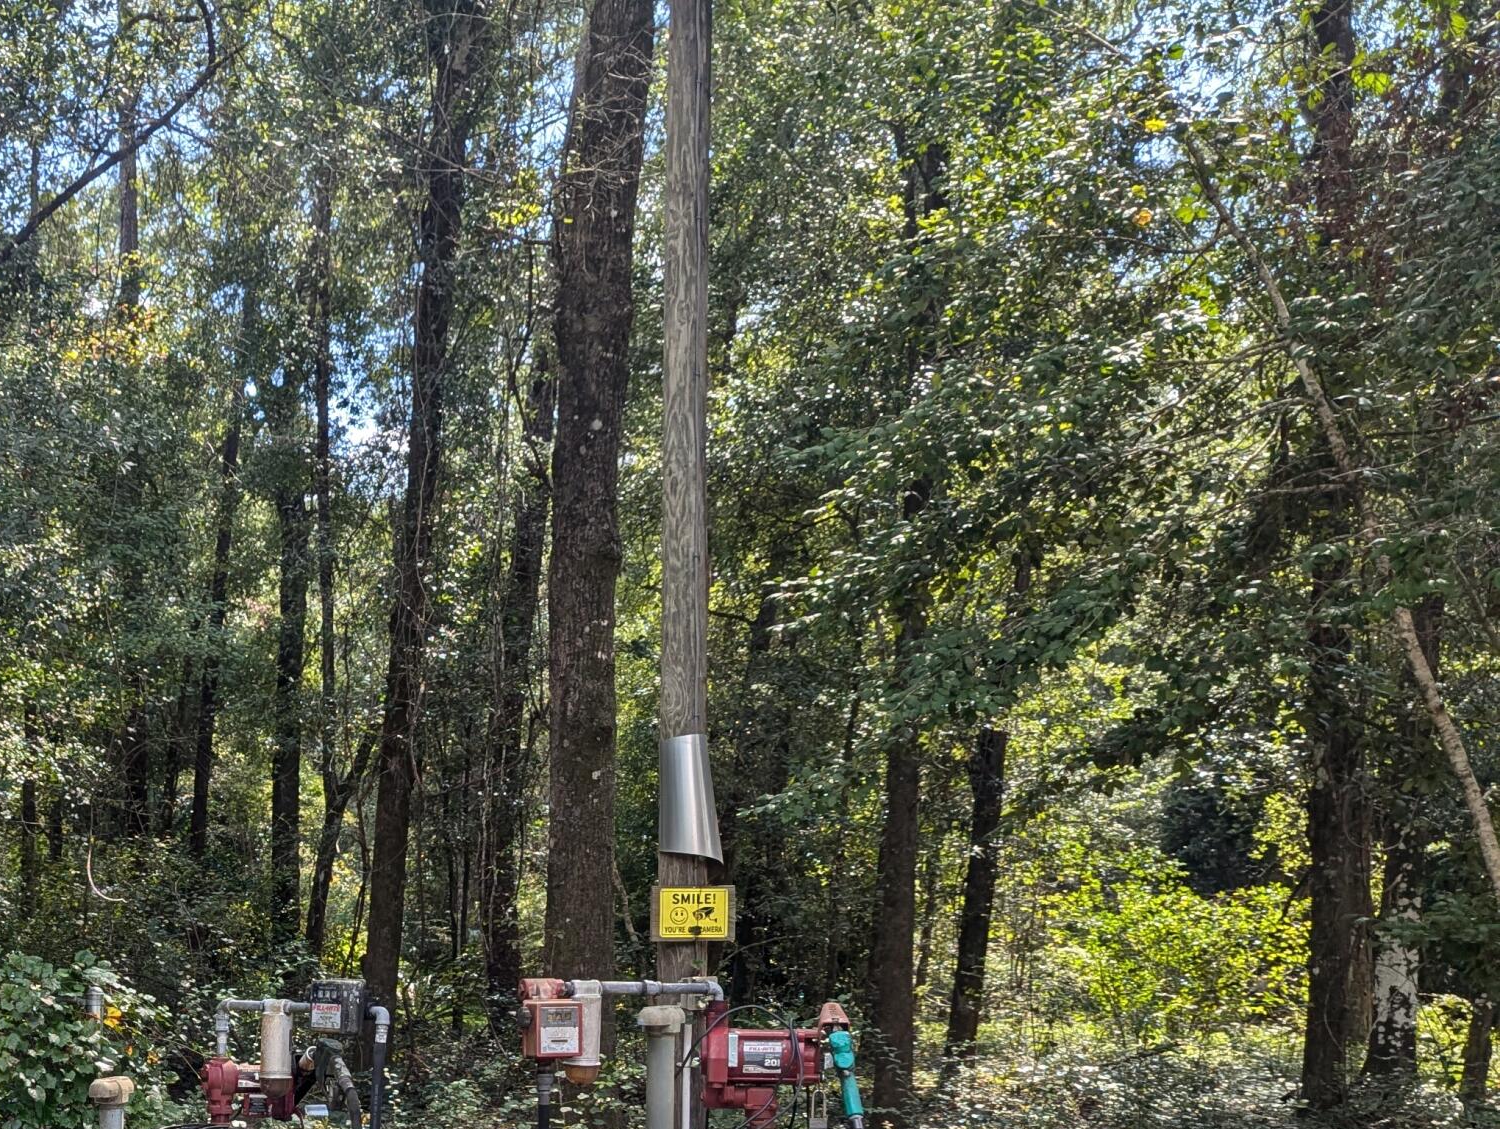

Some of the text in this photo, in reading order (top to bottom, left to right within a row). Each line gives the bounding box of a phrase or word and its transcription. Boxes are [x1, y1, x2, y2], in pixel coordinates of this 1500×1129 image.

[672, 893, 716, 905] SMILE!
[664, 926, 686, 934] YOU'RE
[764, 1058, 777, 1067] 20
